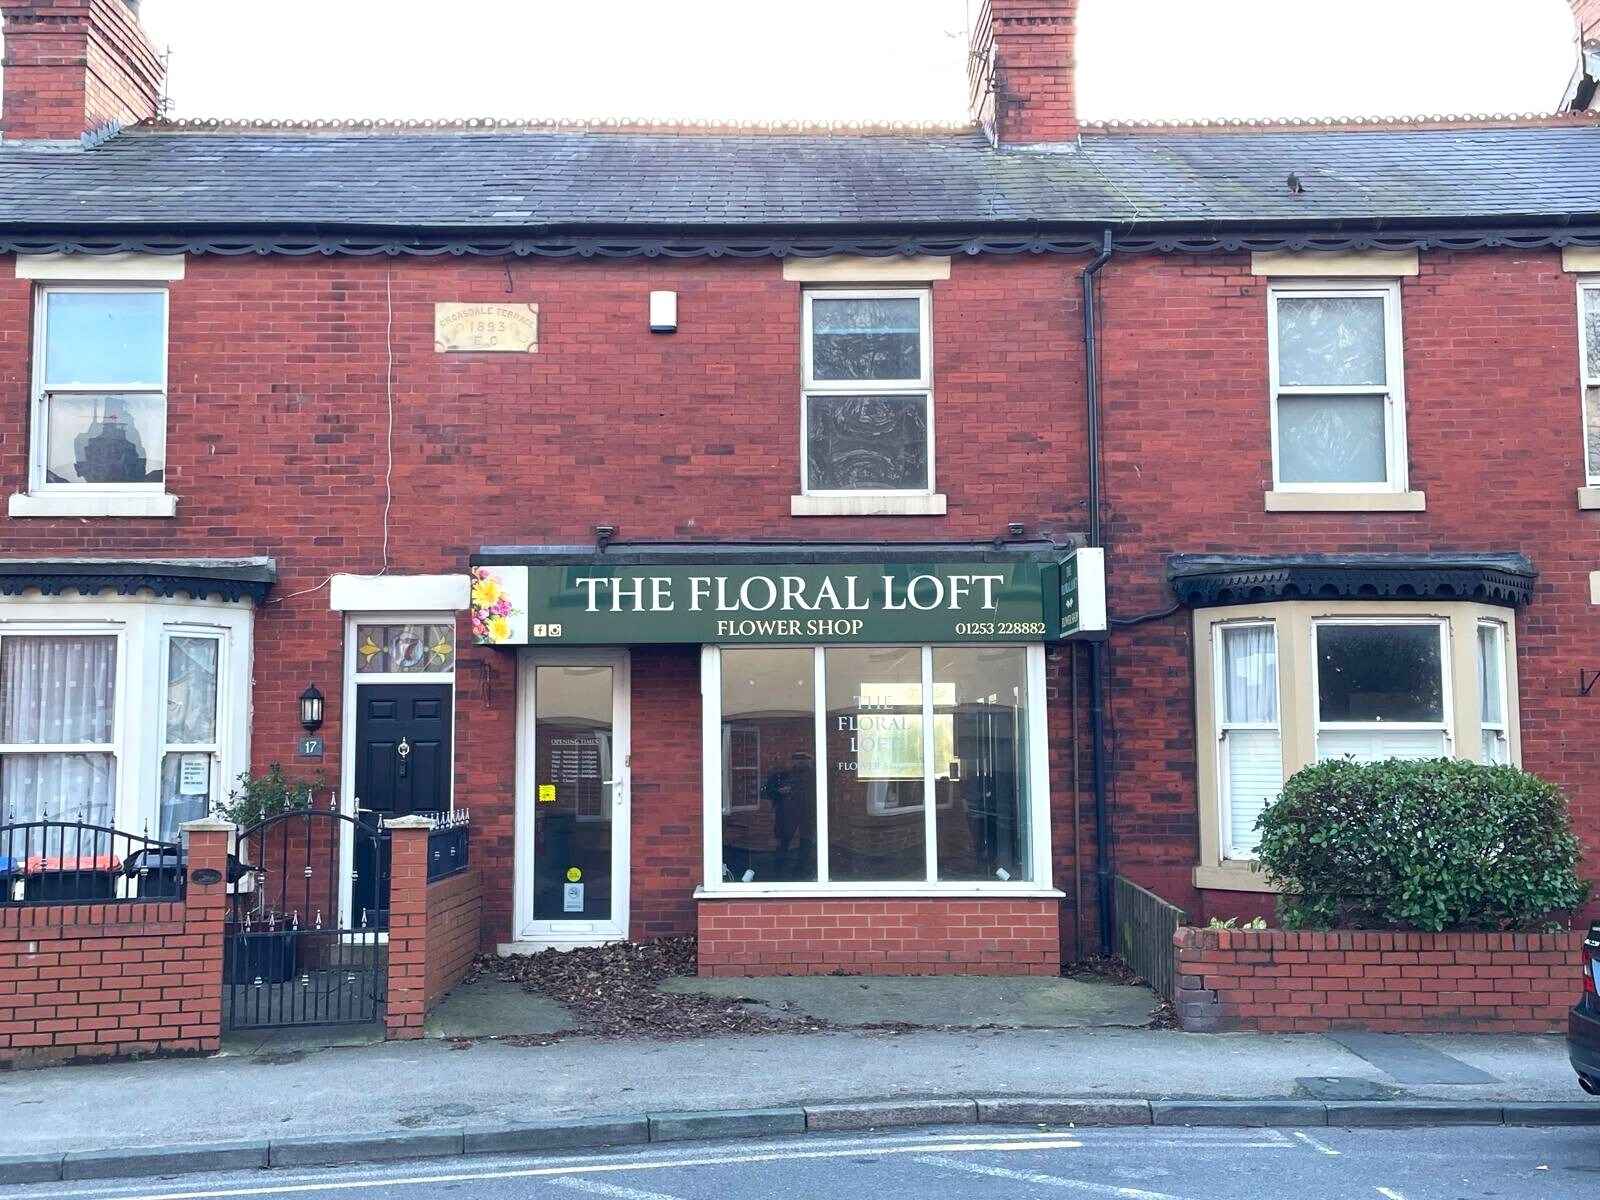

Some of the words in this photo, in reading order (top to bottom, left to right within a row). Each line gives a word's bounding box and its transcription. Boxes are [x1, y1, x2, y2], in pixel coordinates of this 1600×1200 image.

[470, 321, 506, 332] 1893
[576, 576, 675, 613] THE
[687, 575, 870, 613] FLORAL
[881, 574, 1004, 611] LOFT
[717, 619, 802, 637] FLOWER
[806, 618, 864, 636] SHOP
[955, 622, 995, 635] 01253
[997, 621, 1047, 635] 228882
[853, 695, 894, 710] THE
[838, 716, 911, 731] FLORAL
[304, 741, 317, 753] 17
[850, 736, 900, 753] LOFT
